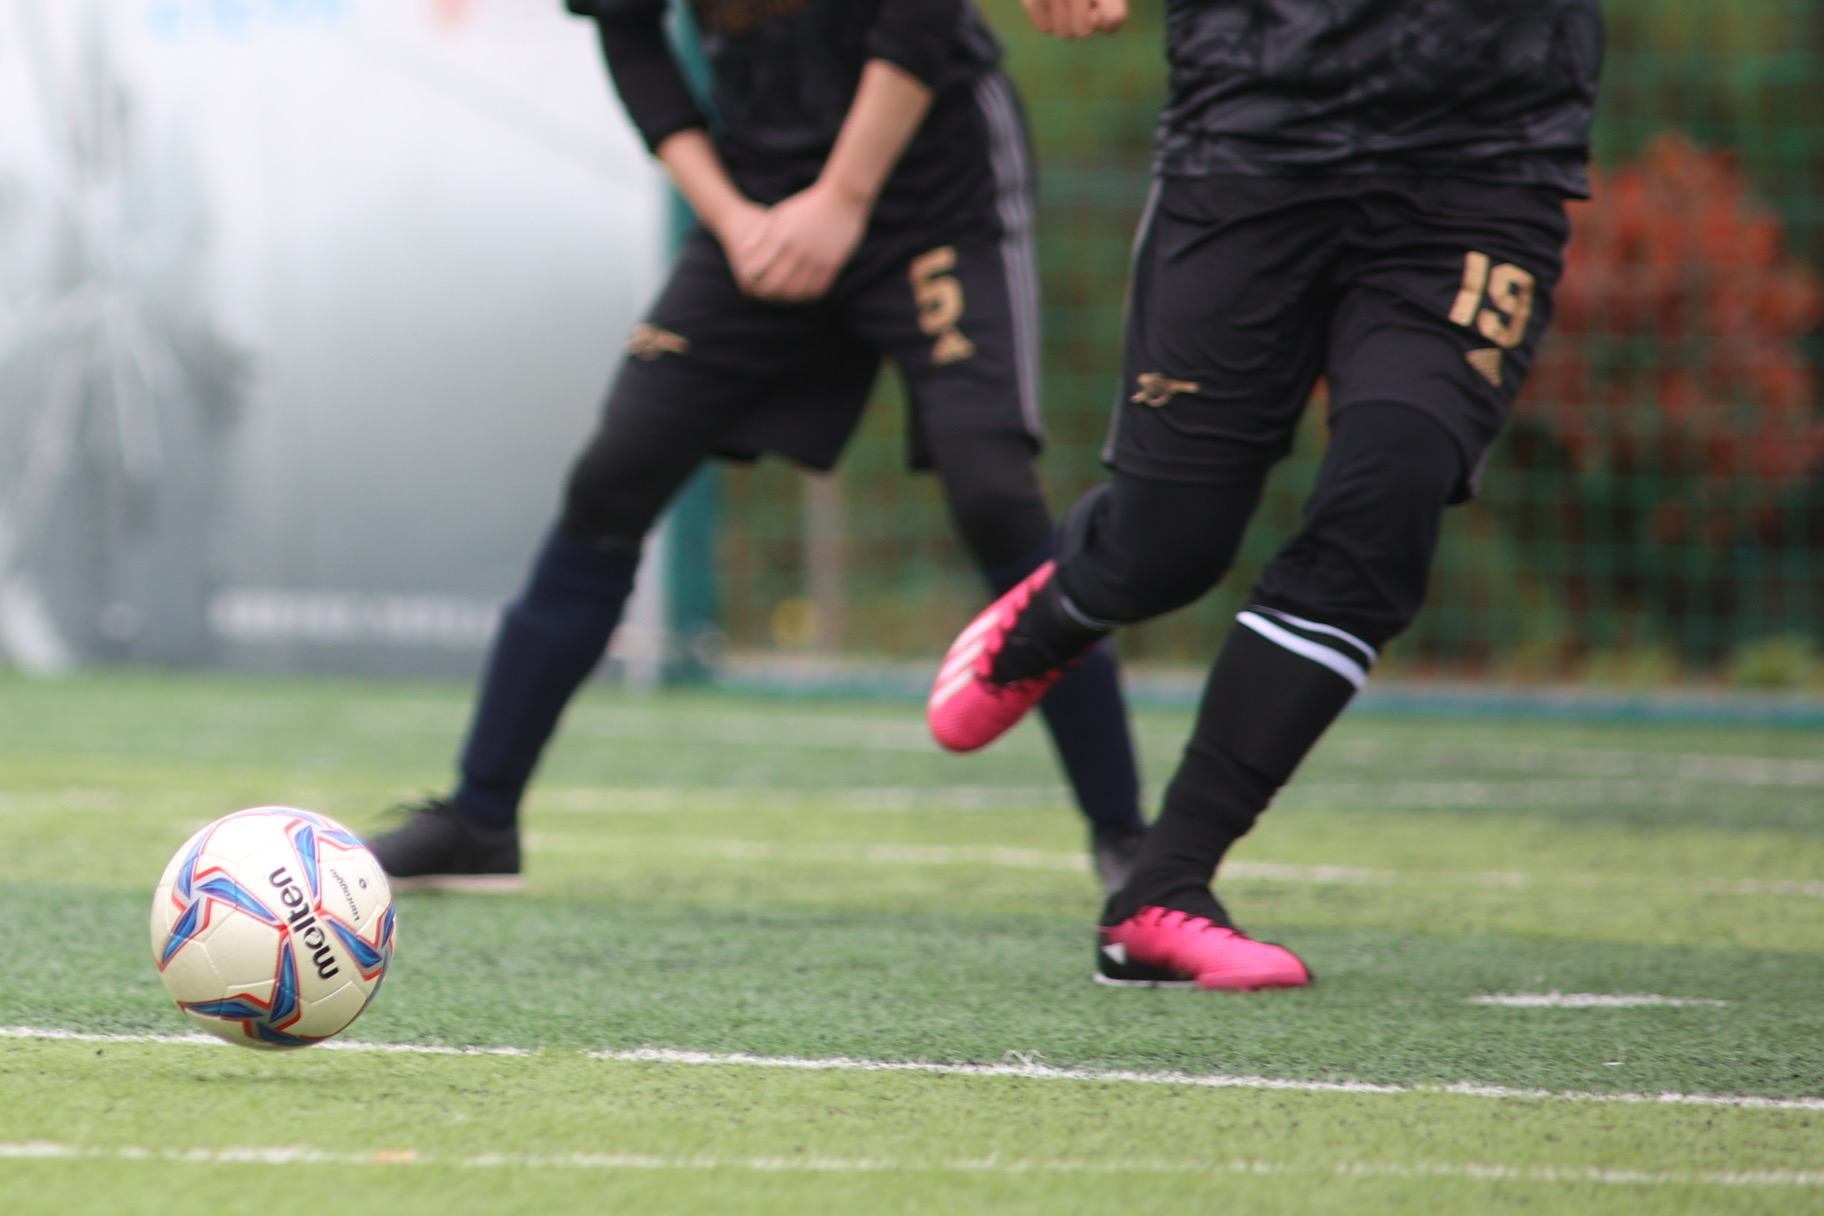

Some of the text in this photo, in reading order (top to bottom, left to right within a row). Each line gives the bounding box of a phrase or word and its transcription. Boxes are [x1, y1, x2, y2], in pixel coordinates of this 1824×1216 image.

[909, 245, 964, 335] 5
[1448, 251, 1536, 348] 19
[269, 866, 340, 980] molten
